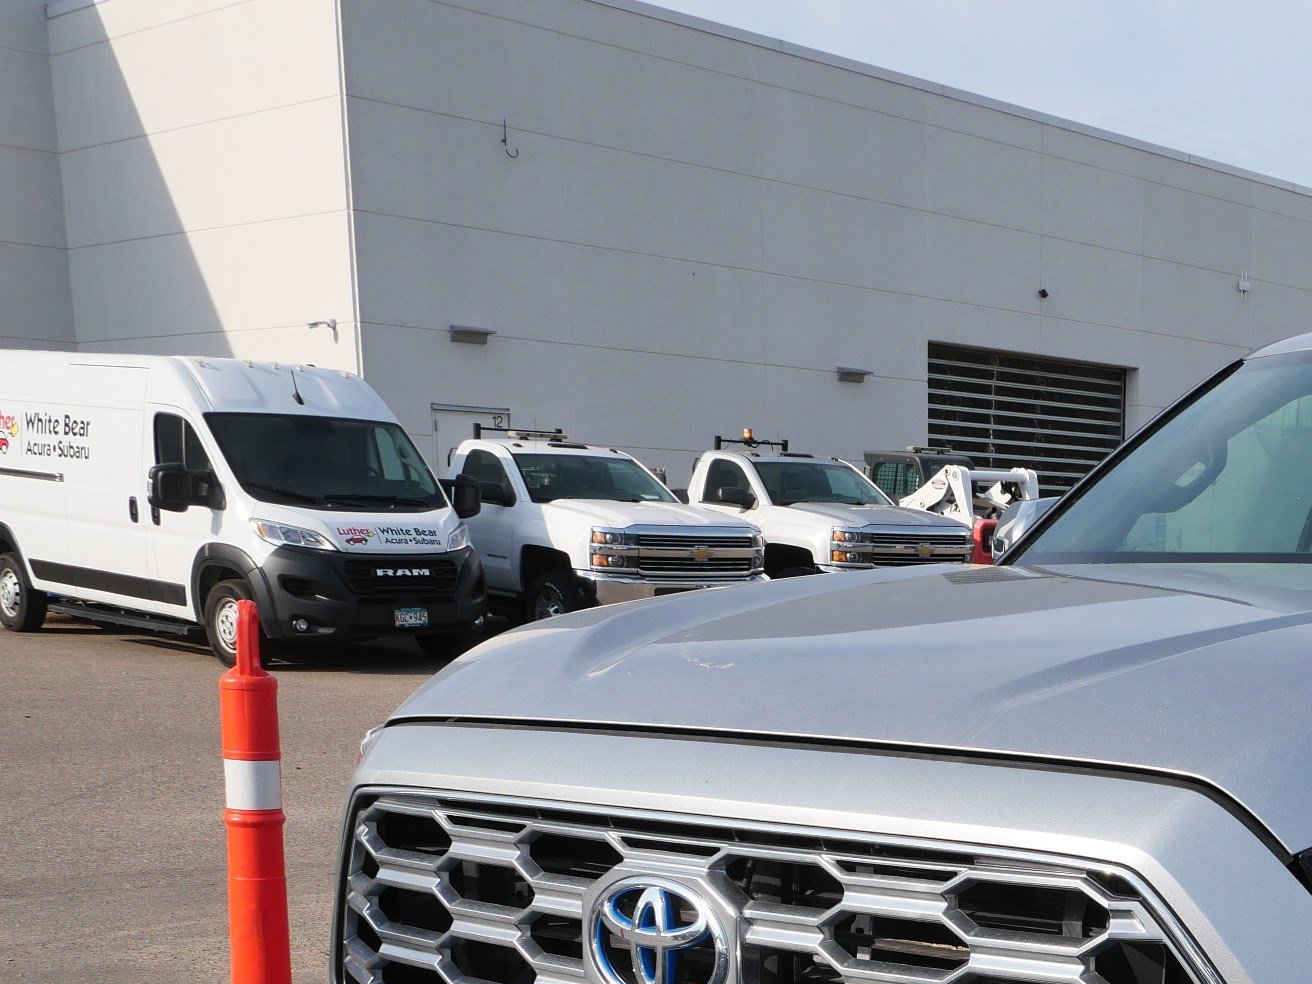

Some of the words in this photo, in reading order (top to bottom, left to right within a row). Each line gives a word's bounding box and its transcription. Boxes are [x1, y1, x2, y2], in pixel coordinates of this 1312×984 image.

[25, 412, 60, 435] White
[63, 414, 90, 437] Bear
[492, 415, 502, 428] 12
[25, 440, 51, 456] Acura
[57, 440, 90, 459] Subaru
[337, 527, 369, 536] Luther
[378, 527, 412, 536] White
[413, 528, 437, 537] Bear
[413, 537, 441, 546] Subaru
[376, 568, 430, 576] RAM
